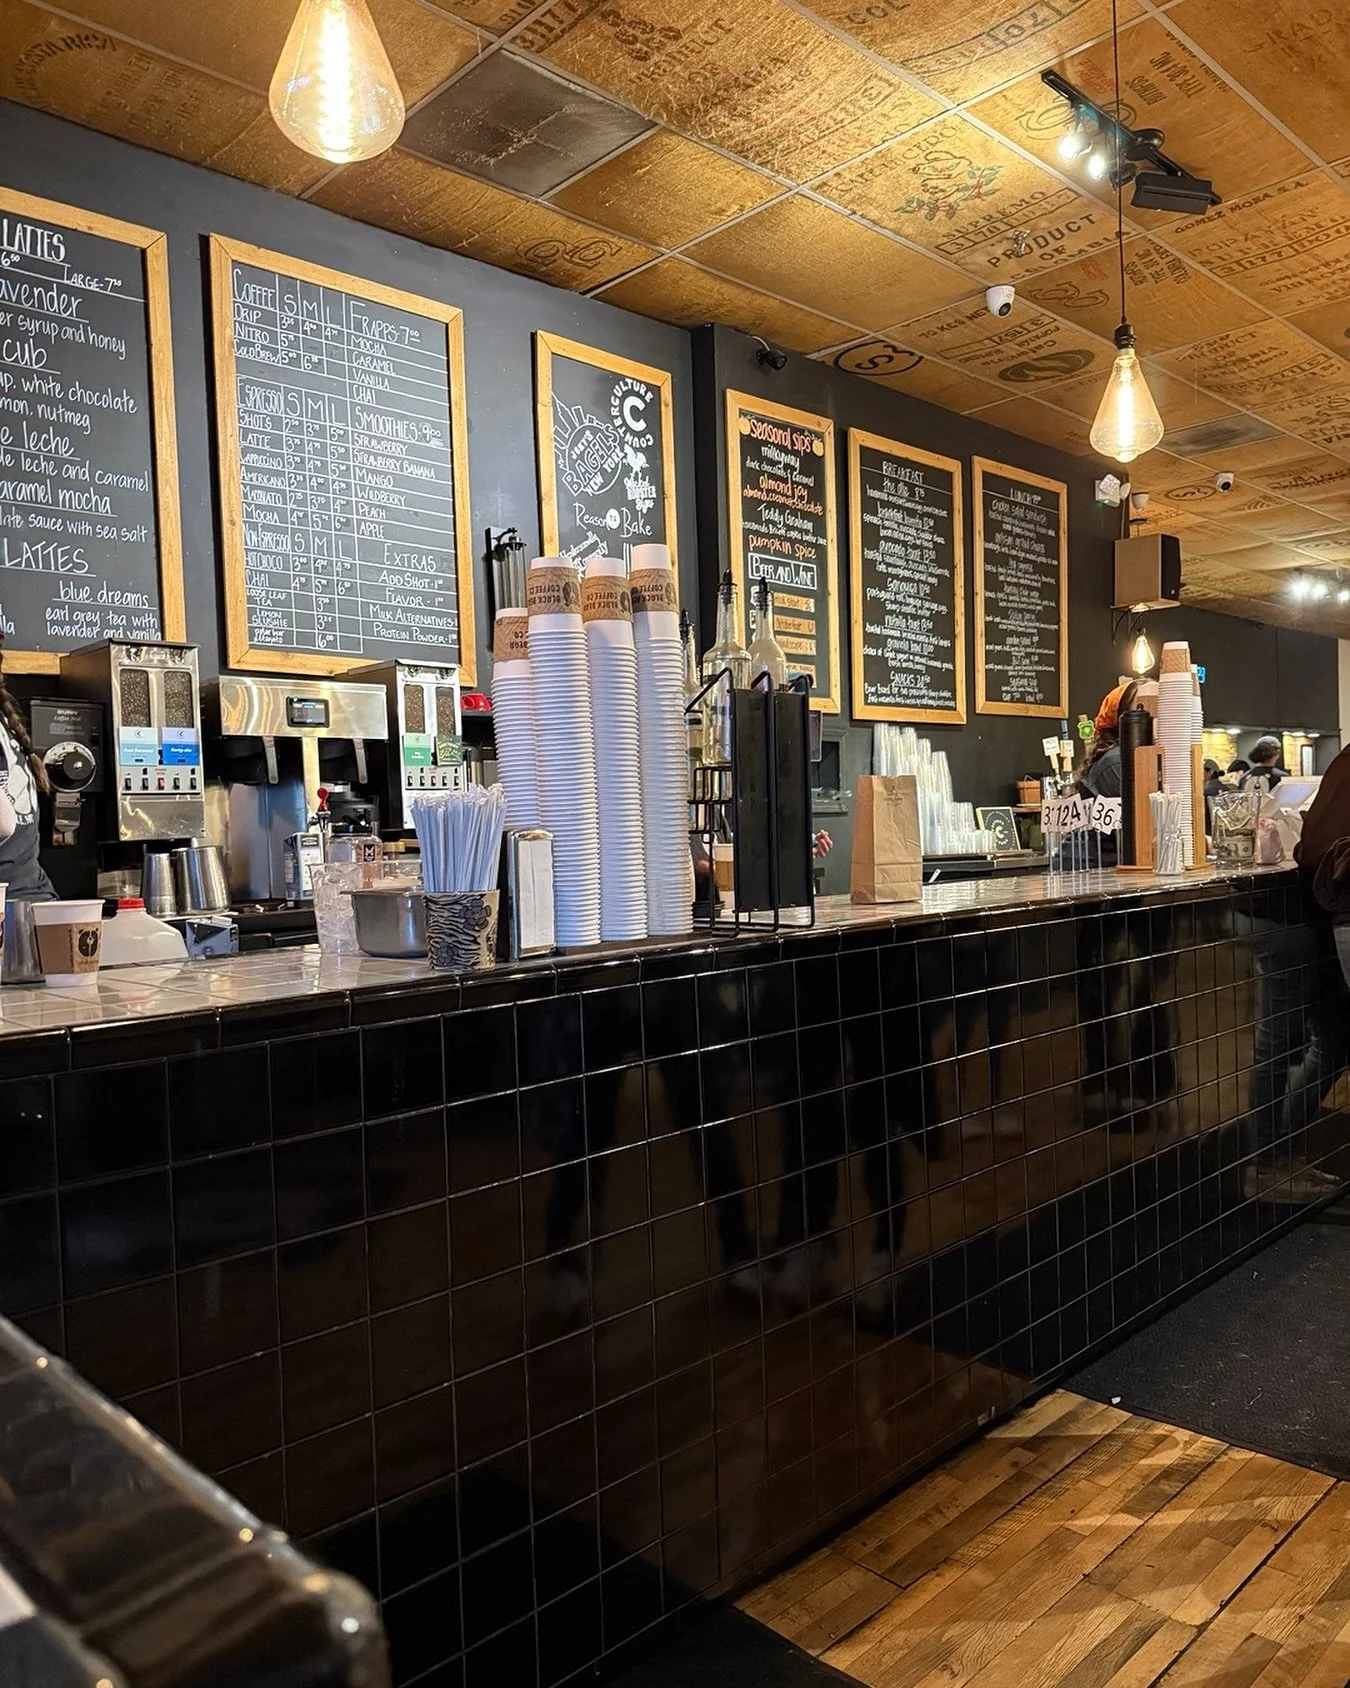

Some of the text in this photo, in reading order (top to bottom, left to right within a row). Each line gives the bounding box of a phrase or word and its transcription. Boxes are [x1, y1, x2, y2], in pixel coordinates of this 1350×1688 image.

[942, 190, 1046, 240] SUPREMO
[3, 218, 66, 262] LATTES
[1039, 244, 1066, 262] OF
[234, 303, 262, 324] DRIP
[284, 294, 297, 316] S
[302, 300, 318, 322] M
[18, 314, 126, 360] syrup and honey
[235, 322, 270, 345] NITRO
[3, 339, 47, 369] cub
[351, 335, 387, 356] MOCHA
[352, 351, 395, 376] CARAMEL
[353, 368, 390, 390] VANILLA
[21, 374, 64, 399] white
[69, 381, 138, 414] chocolate
[353, 384, 376, 405] CHAI
[37, 404, 91, 435] nutmeg
[239, 409, 272, 430] SHOTS
[287, 392, 300, 417] S
[308, 398, 324, 421] M
[332, 403, 346, 425] L
[623, 396, 647, 432] C
[23, 421, 75, 458] leche
[239, 428, 271, 448] LATTE
[354, 433, 408, 456] STRAWBERRY
[750, 419, 811, 456] seasonal sips
[21, 452, 57, 476] leche
[62, 460, 90, 482] and
[95, 470, 150, 492] caramel
[353, 448, 436, 479] STRAWBERRY BANANA
[562, 424, 620, 497] BAGELS
[584, 445, 626, 496] NEW YORK
[240, 466, 286, 488] AMERICANO
[356, 466, 393, 488] MANGO
[882, 461, 924, 484] BREAKFAST
[356, 484, 406, 507] WILDBERRY
[759, 473, 808, 504] almond joy
[59, 487, 112, 514] mocha
[358, 502, 386, 519] PEACH
[243, 503, 279, 525] MOCHA
[620, 507, 653, 538] Bake
[757, 503, 784, 528] Teddy
[785, 510, 813, 533] Graham
[28, 513, 63, 532] sauce
[67, 519, 93, 538] with
[96, 526, 118, 539] sea
[121, 524, 148, 543] salt
[359, 521, 385, 539] APPLE
[4, 537, 89, 574] LATTES
[294, 533, 305, 553] S
[314, 536, 328, 557] M
[338, 540, 353, 562] L
[748, 534, 817, 558] pumpkin spice
[384, 543, 436, 573] EXTRAS
[246, 569, 269, 587] CHAI
[378, 570, 431, 588] ADD SHOT
[753, 556, 814, 586] BEER AND WINE
[59, 580, 149, 608] blue dreams
[254, 597, 273, 607] TEA
[268, 591, 288, 600] LEAF
[386, 588, 425, 607] FLAVOR
[538, 595, 561, 604] BLACK
[597, 601, 618, 609] BLACK
[45, 605, 158, 629] earl grey tea with
[252, 615, 288, 627] SLUSHIE
[256, 608, 282, 619] LEMON
[369, 604, 393, 621] MILK
[47, 623, 162, 642] lavender and vanilla
[373, 622, 445, 644] PROTEIN POWDER
[1093, 803, 1115, 826] 36
